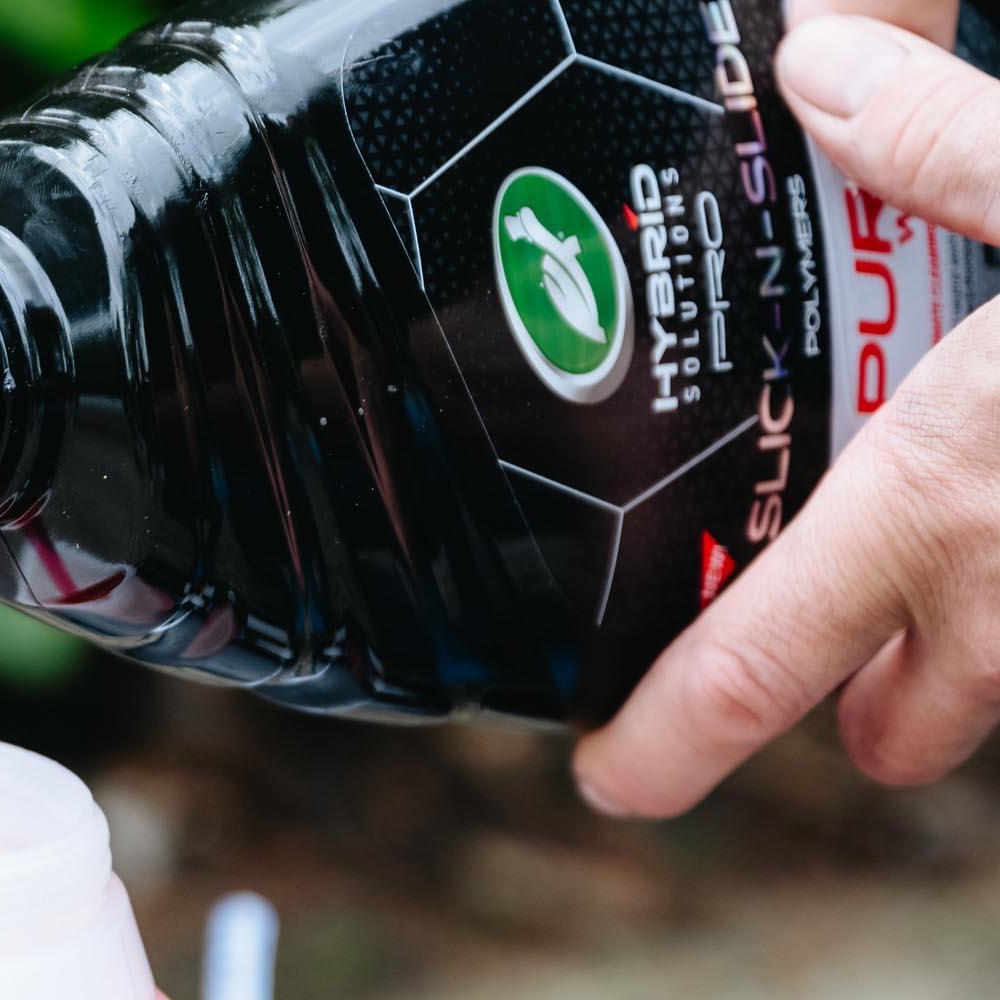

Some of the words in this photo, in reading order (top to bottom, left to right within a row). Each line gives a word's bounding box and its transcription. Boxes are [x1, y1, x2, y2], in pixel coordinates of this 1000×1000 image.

[630, 163, 679, 413] HYBRID
[660, 166, 701, 404] SOLUTIONS
[694, 190, 734, 373] PRO
[786, 173, 822, 359] POLYMERS
